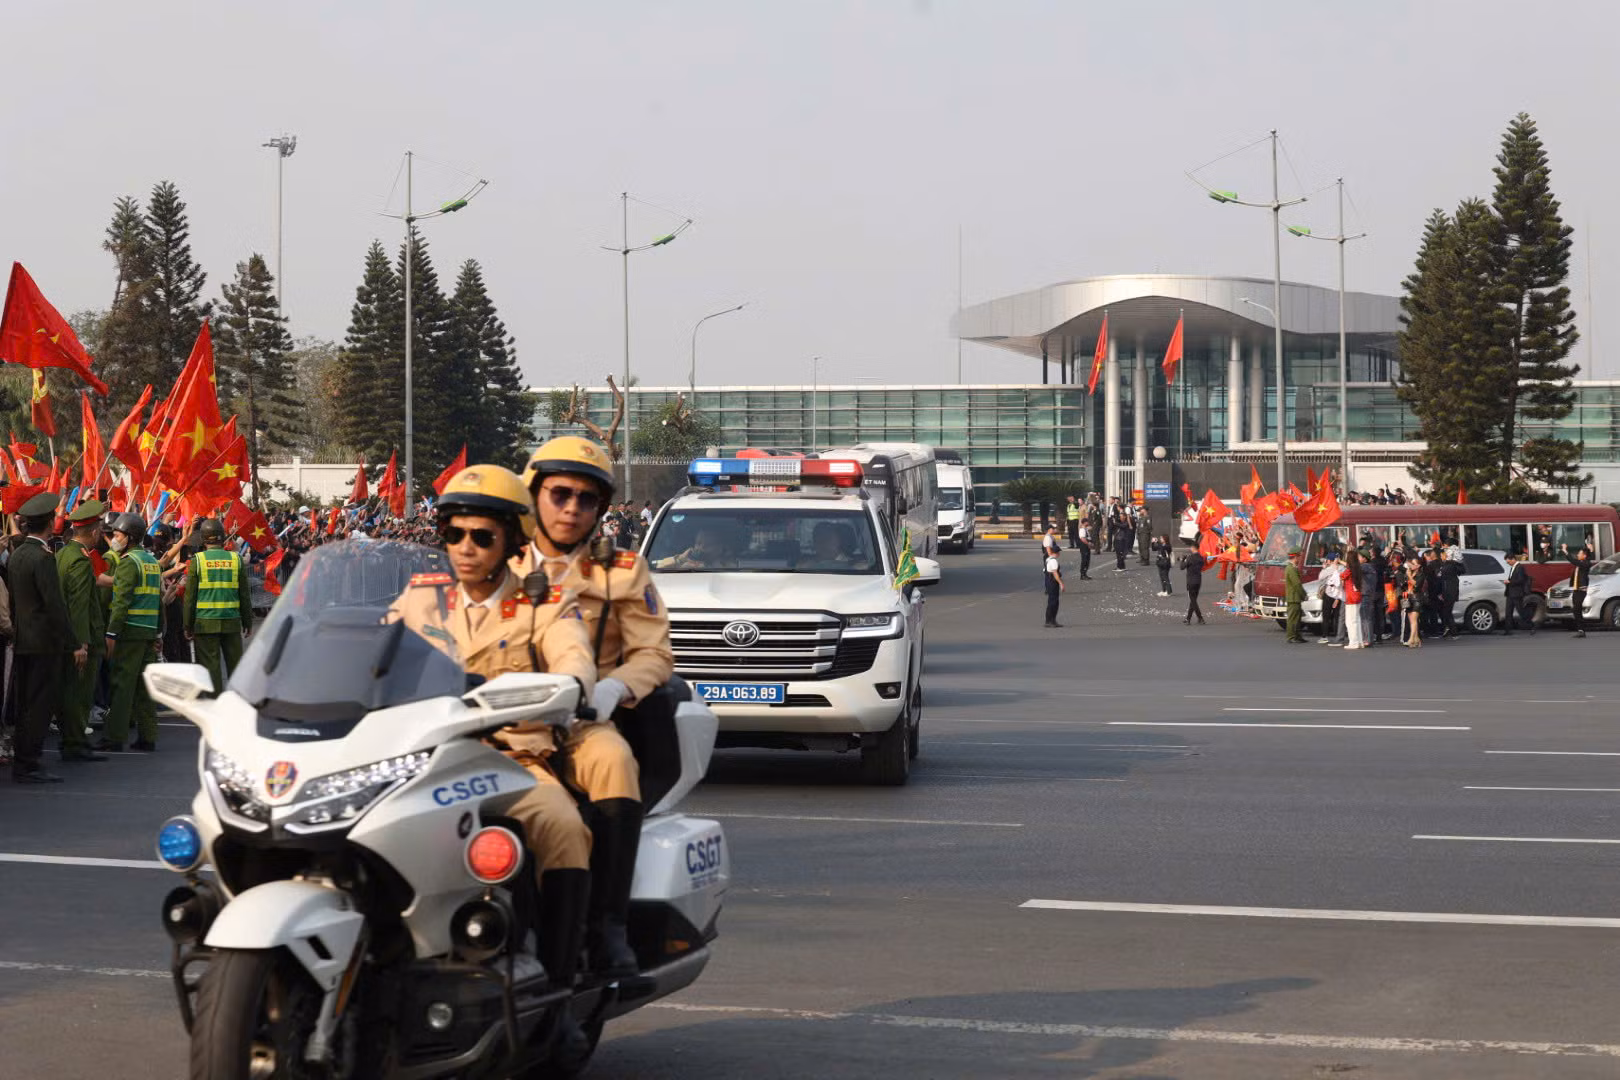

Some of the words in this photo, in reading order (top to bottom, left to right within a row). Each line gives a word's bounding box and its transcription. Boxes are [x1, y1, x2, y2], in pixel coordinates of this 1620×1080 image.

[703, 686, 777, 699] 29A-063.89
[432, 773, 499, 806] CSGT
[686, 835, 721, 875] CSGT
